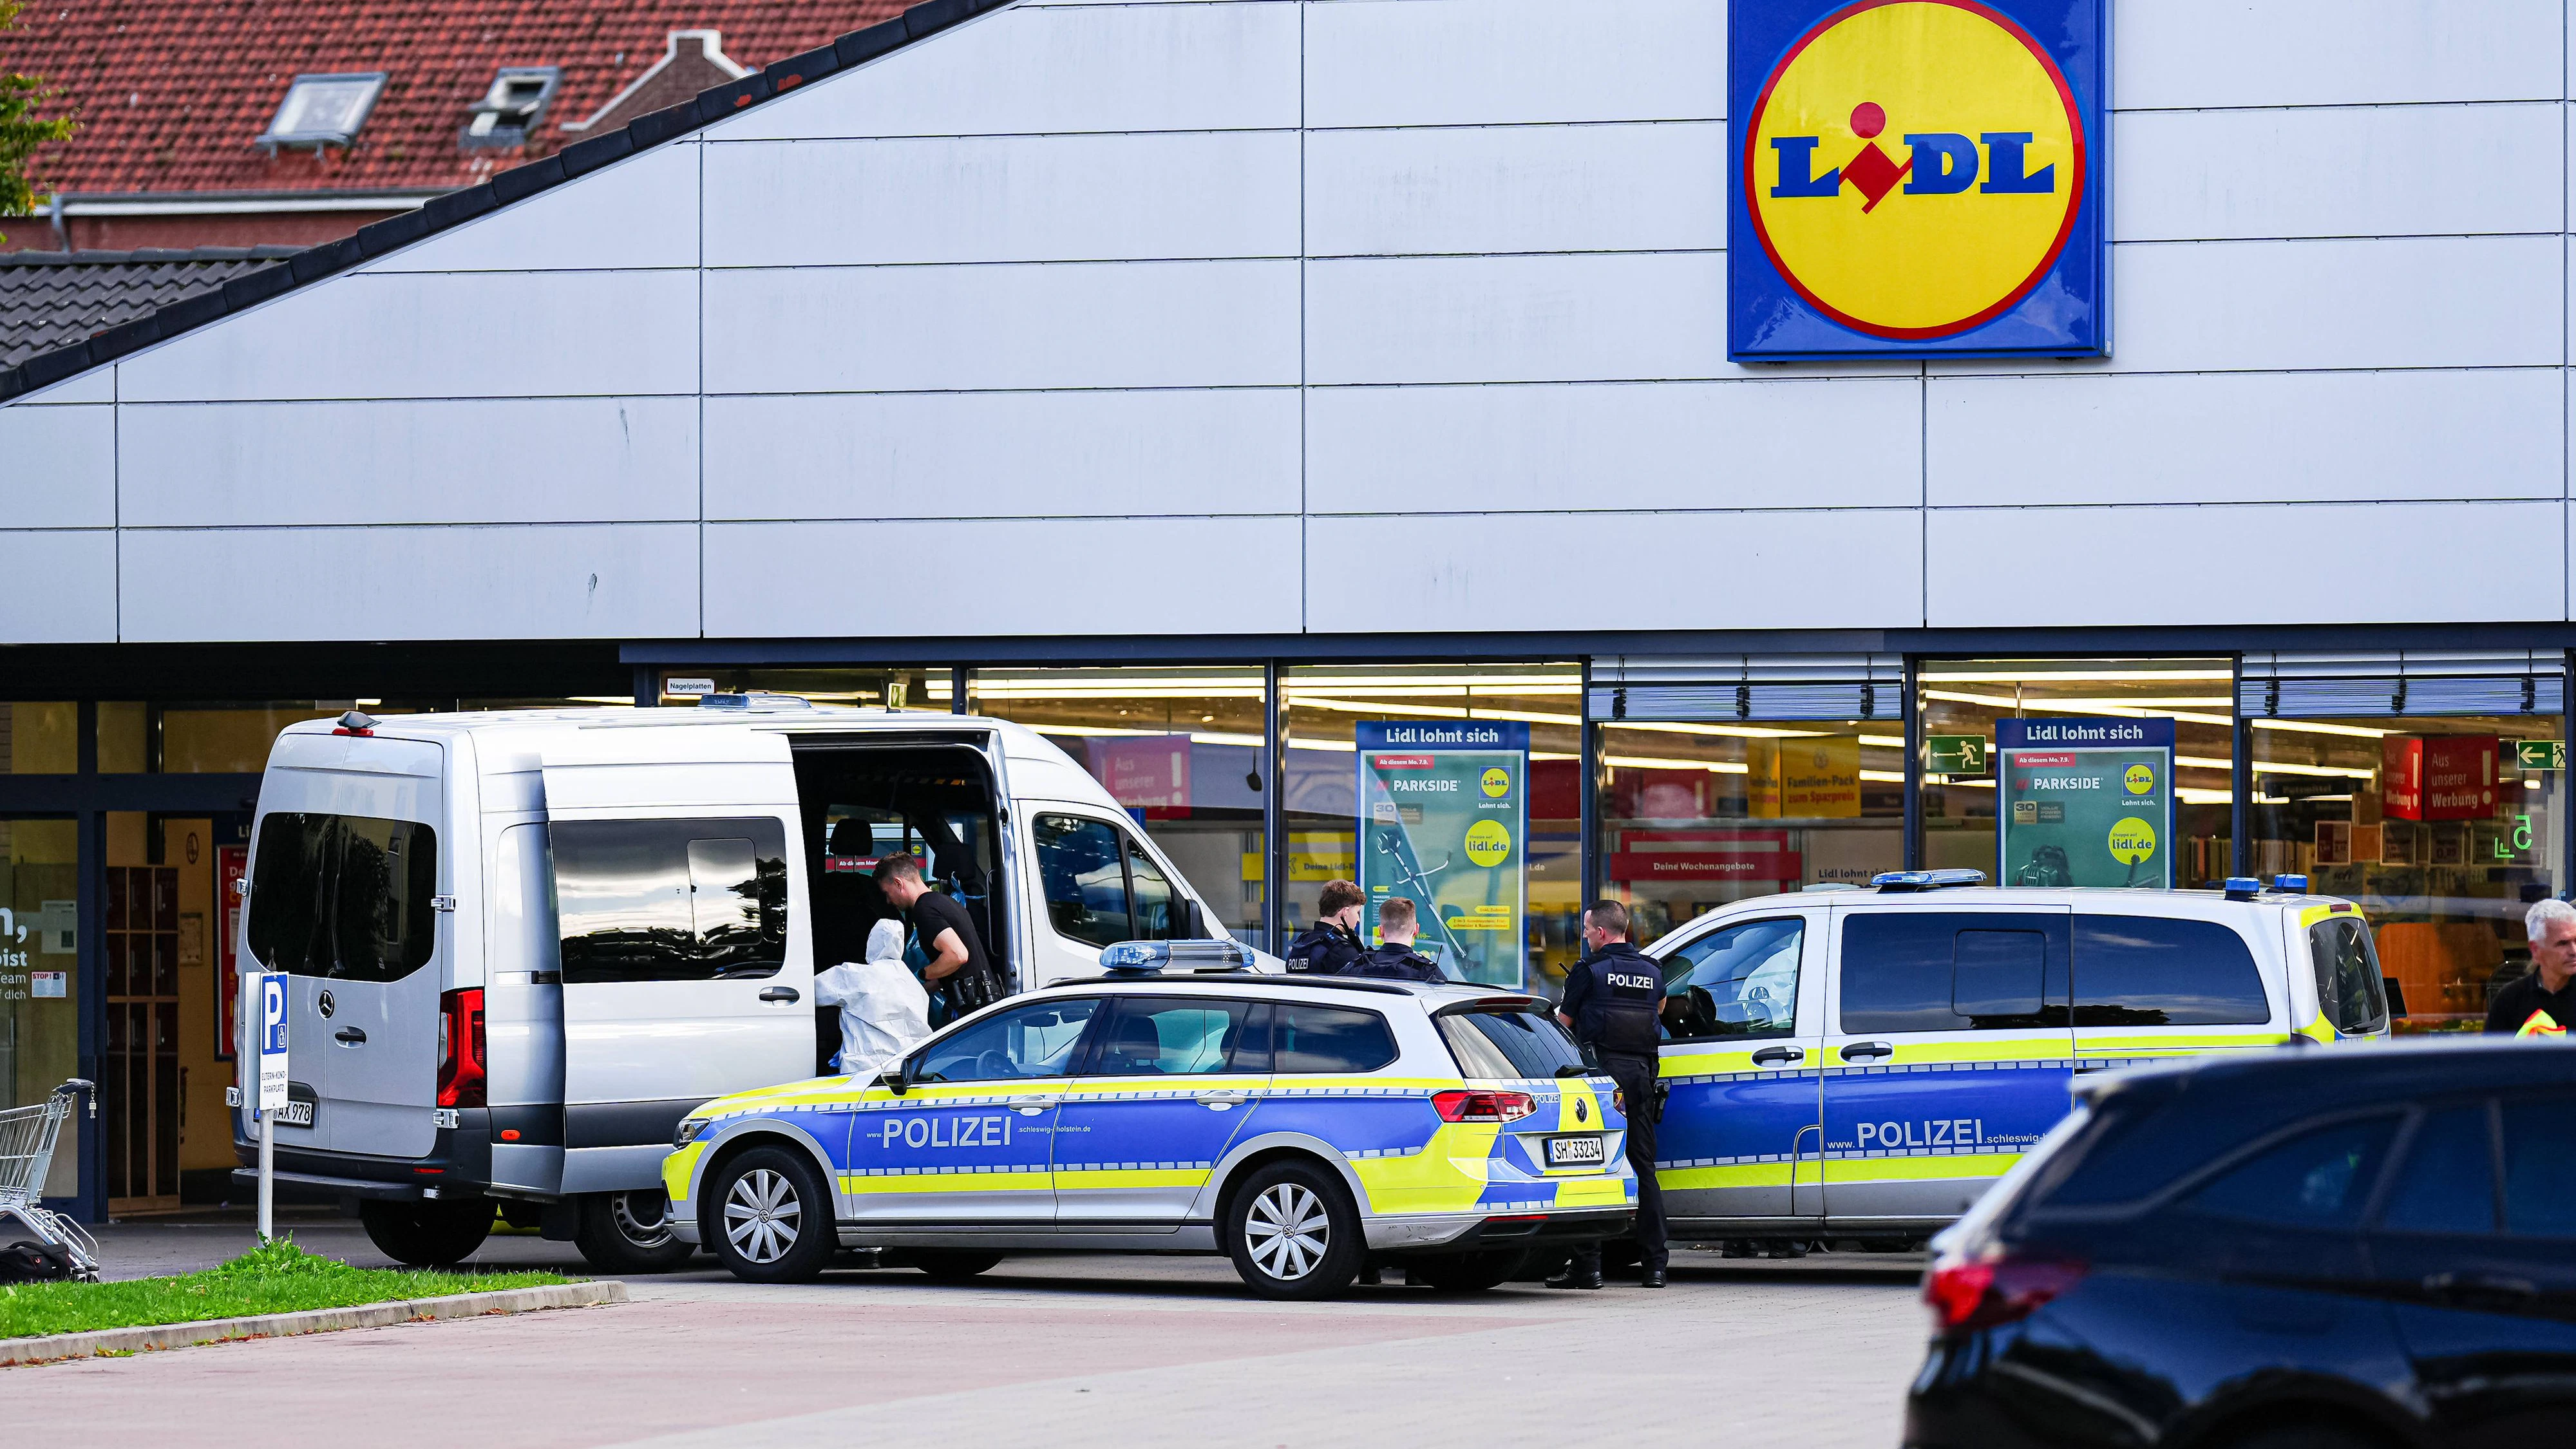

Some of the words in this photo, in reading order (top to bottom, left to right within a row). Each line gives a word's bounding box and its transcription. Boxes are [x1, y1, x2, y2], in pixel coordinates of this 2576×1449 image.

[1386, 728, 1416, 743] Lidl
[1420, 728, 1463, 743] lohnt
[1466, 728, 1499, 743] sich
[2027, 725, 2058, 741] Lidl
[2062, 725, 2105, 740] lohnt
[2110, 724, 2143, 739] sich
[1115, 757, 1134, 772] Aus
[2432, 753, 2449, 768] Aus
[1788, 775, 1855, 788] Familien-Pack
[2432, 773, 2467, 786] unserer
[1788, 793, 1808, 803] zum
[1810, 791, 1855, 804] Sparpreis
[2432, 791, 2477, 809] Werbung
[1469, 840, 1506, 851] lidl.de
[2112, 838, 2152, 849] lidl.de
[1680, 862, 1755, 872] Wochenangebote
[1819, 869, 1837, 878] Lidl
[1841, 869, 1868, 878] lohnt
[1288, 958, 1309, 971] POLIZEI
[1607, 973, 1653, 990] POLIZEI
[5, 989, 26, 999] dich
[264, 981, 283, 1050] P
[1535, 1095, 1560, 1104] POLIZEI
[292, 1103, 310, 1122] 978
[883, 1116, 1012, 1148] POLIZEI
[1857, 1119, 1982, 1148] POLIZEI
[1555, 1142, 1567, 1159] SH
[1573, 1141, 1600, 1159] 33234
